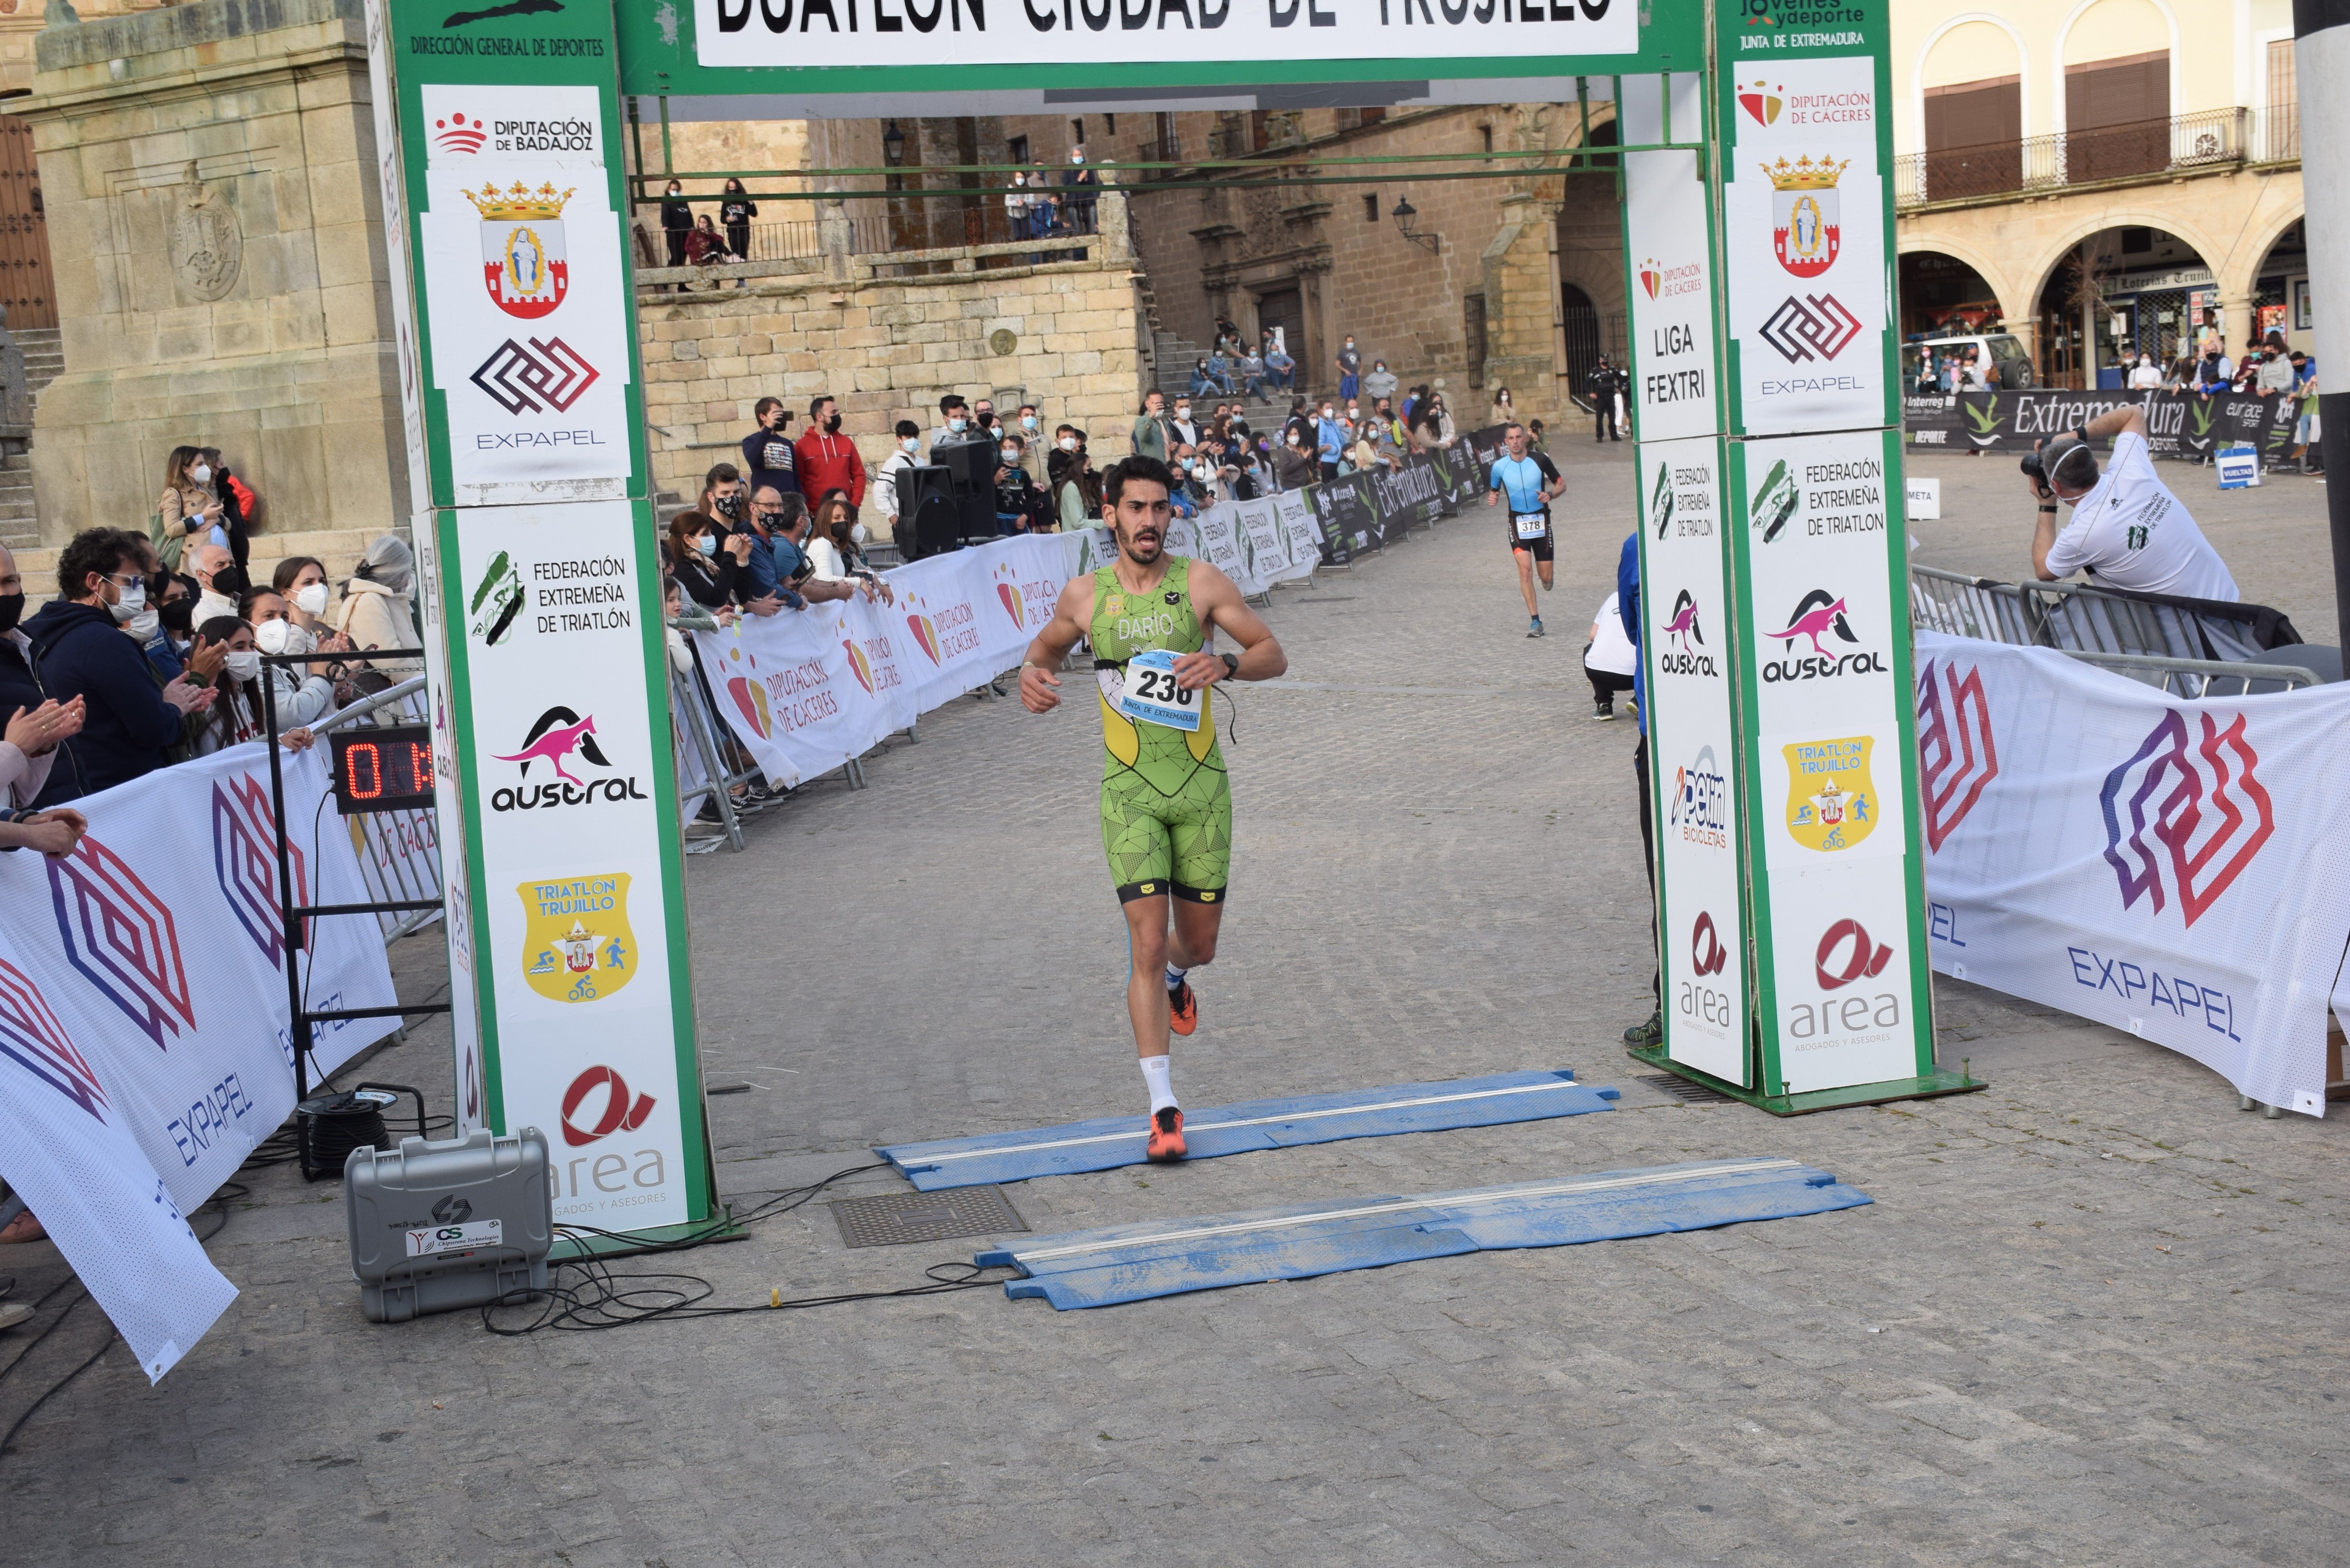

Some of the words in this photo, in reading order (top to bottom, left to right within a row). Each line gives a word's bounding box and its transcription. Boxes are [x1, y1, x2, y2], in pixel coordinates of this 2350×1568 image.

[411, 33, 473, 55] DIRECCIÓN
[477, 37, 530, 56] GENERAL
[532, 39, 547, 56] DE
[550, 39, 604, 57] DEPORTES
[1740, 34, 1769, 51] JUNTA
[1774, 34, 1787, 48] DE
[1790, 32, 1864, 48] EXTREMADURA
[1791, 91, 1870, 108] DIPUTACIÓN
[494, 117, 592, 136] DIPUTACIÓN
[1791, 111, 1807, 124] DE
[1813, 108, 1871, 123] CÁCERES
[496, 140, 512, 151] DE
[516, 136, 593, 151] BADAJOZ
[1664, 262, 1701, 282] DIPUTACIÓN
[1665, 284, 1673, 297] DE
[1674, 279, 1701, 296] CÁCERES
[1654, 324, 1694, 358] LIGA
[1647, 369, 1705, 405] FEXTRI
[1761, 376, 1865, 395] EXPAPEL
[476, 430, 606, 450] EXPAPEL
[1675, 463, 1710, 486] FEDERACIÓN
[1806, 457, 1881, 483] FEDERACIÓN
[1678, 490, 1710, 511] EXTREMEÑA
[1810, 486, 1880, 510] EXTREMEÑA
[1908, 491, 1932, 501] META
[2137, 491, 2160, 521] FEDERACIÓN
[1522, 521, 1540, 531] 378
[1678, 519, 1686, 537] DE
[1687, 518, 1713, 537] TRIATLON
[1808, 517, 1823, 536] DE
[1826, 512, 1883, 535] TRIATLON
[2150, 522, 2158, 530] DE
[534, 555, 625, 581] FEDERACIÓN
[539, 582, 625, 607] EXTREMEÑA
[538, 615, 557, 633] DE
[561, 607, 631, 632] TRIATLÓN
[933, 599, 974, 633] DIPUTACIÓN
[1119, 610, 1173, 640] DARÍO
[942, 639, 952, 659] DE
[1662, 653, 1718, 677] austral
[1762, 652, 1888, 683] austral
[766, 656, 829, 700] DIPUTACIÓN
[777, 707, 794, 733] DE
[793, 690, 837, 728] CÁCERES
[1124, 700, 1141, 711] JUNTA
[1154, 709, 1197, 722] EXTREMADURA
[1796, 741, 1862, 759] TRIATLÓN
[1800, 757, 1861, 775] TRUJILLO
[491, 777, 649, 812] austral
[1683, 826, 1726, 849] BICICLETAS
[534, 878, 616, 900] TRIATLÓN
[538, 895, 615, 917] TRUJILLO
[1681, 981, 1730, 1028] area
[2068, 947, 2241, 1043] EXPAPEL
[1789, 993, 1900, 1039] area
[1682, 1018, 1702, 1034] ABOGADOS
[1707, 1027, 1725, 1040] ASESORES
[1795, 1040, 1839, 1052] ABOGADOS
[1850, 1033, 1891, 1045] ASESORES
[167, 1071, 253, 1168] EXPAPEL
[600, 1201, 605, 1210] Y
[610, 1193, 666, 1209] ASESORES
[436, 1227, 463, 1241] CS
[438, 1239, 466, 1247] Chipserena
[467, 1235, 499, 1243] Technologies
